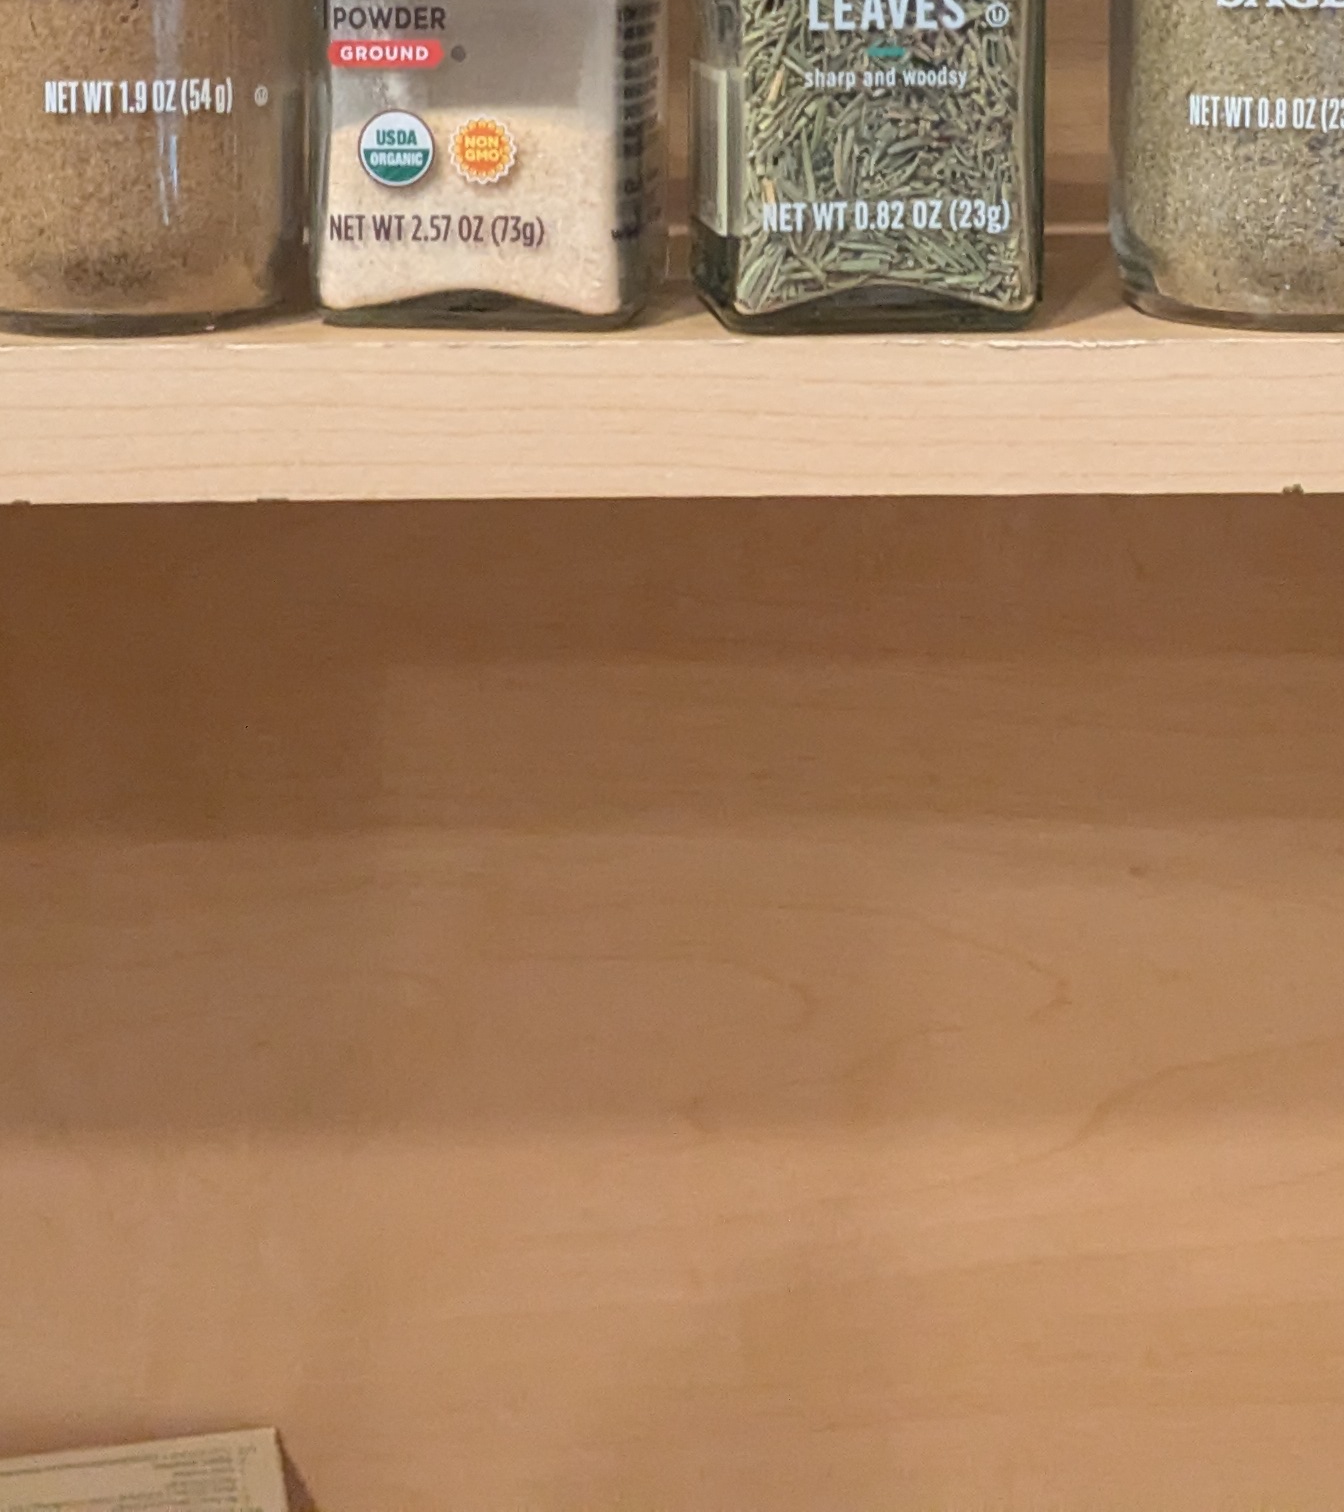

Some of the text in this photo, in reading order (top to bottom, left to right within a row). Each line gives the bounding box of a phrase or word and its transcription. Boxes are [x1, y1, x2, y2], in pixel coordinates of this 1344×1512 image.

[333, 7, 447, 31] POWDER
[340, 46, 429, 61] GROUND
[805, 66, 968, 89] sharp and woodsy
[44, 81, 78, 114] NET
[83, 80, 113, 113] WT
[119, 80, 146, 113] 1.9
[152, 79, 177, 113] OZ
[1189, 95, 1221, 126] NET
[1224, 96, 1254, 127] WT
[1257, 98, 1286, 129] 0.8
[1292, 98, 1316, 129] OZ
[376, 129, 417, 146] USDA
[465, 135, 499, 149] NON
[370, 151, 423, 167] ORGANIC
[465, 149, 499, 162] GMO
[763, 198, 1010, 234] NET WT 0.82 OZ (23g)
[330, 214, 545, 247] NET WT 2.57 OZ (73g)
